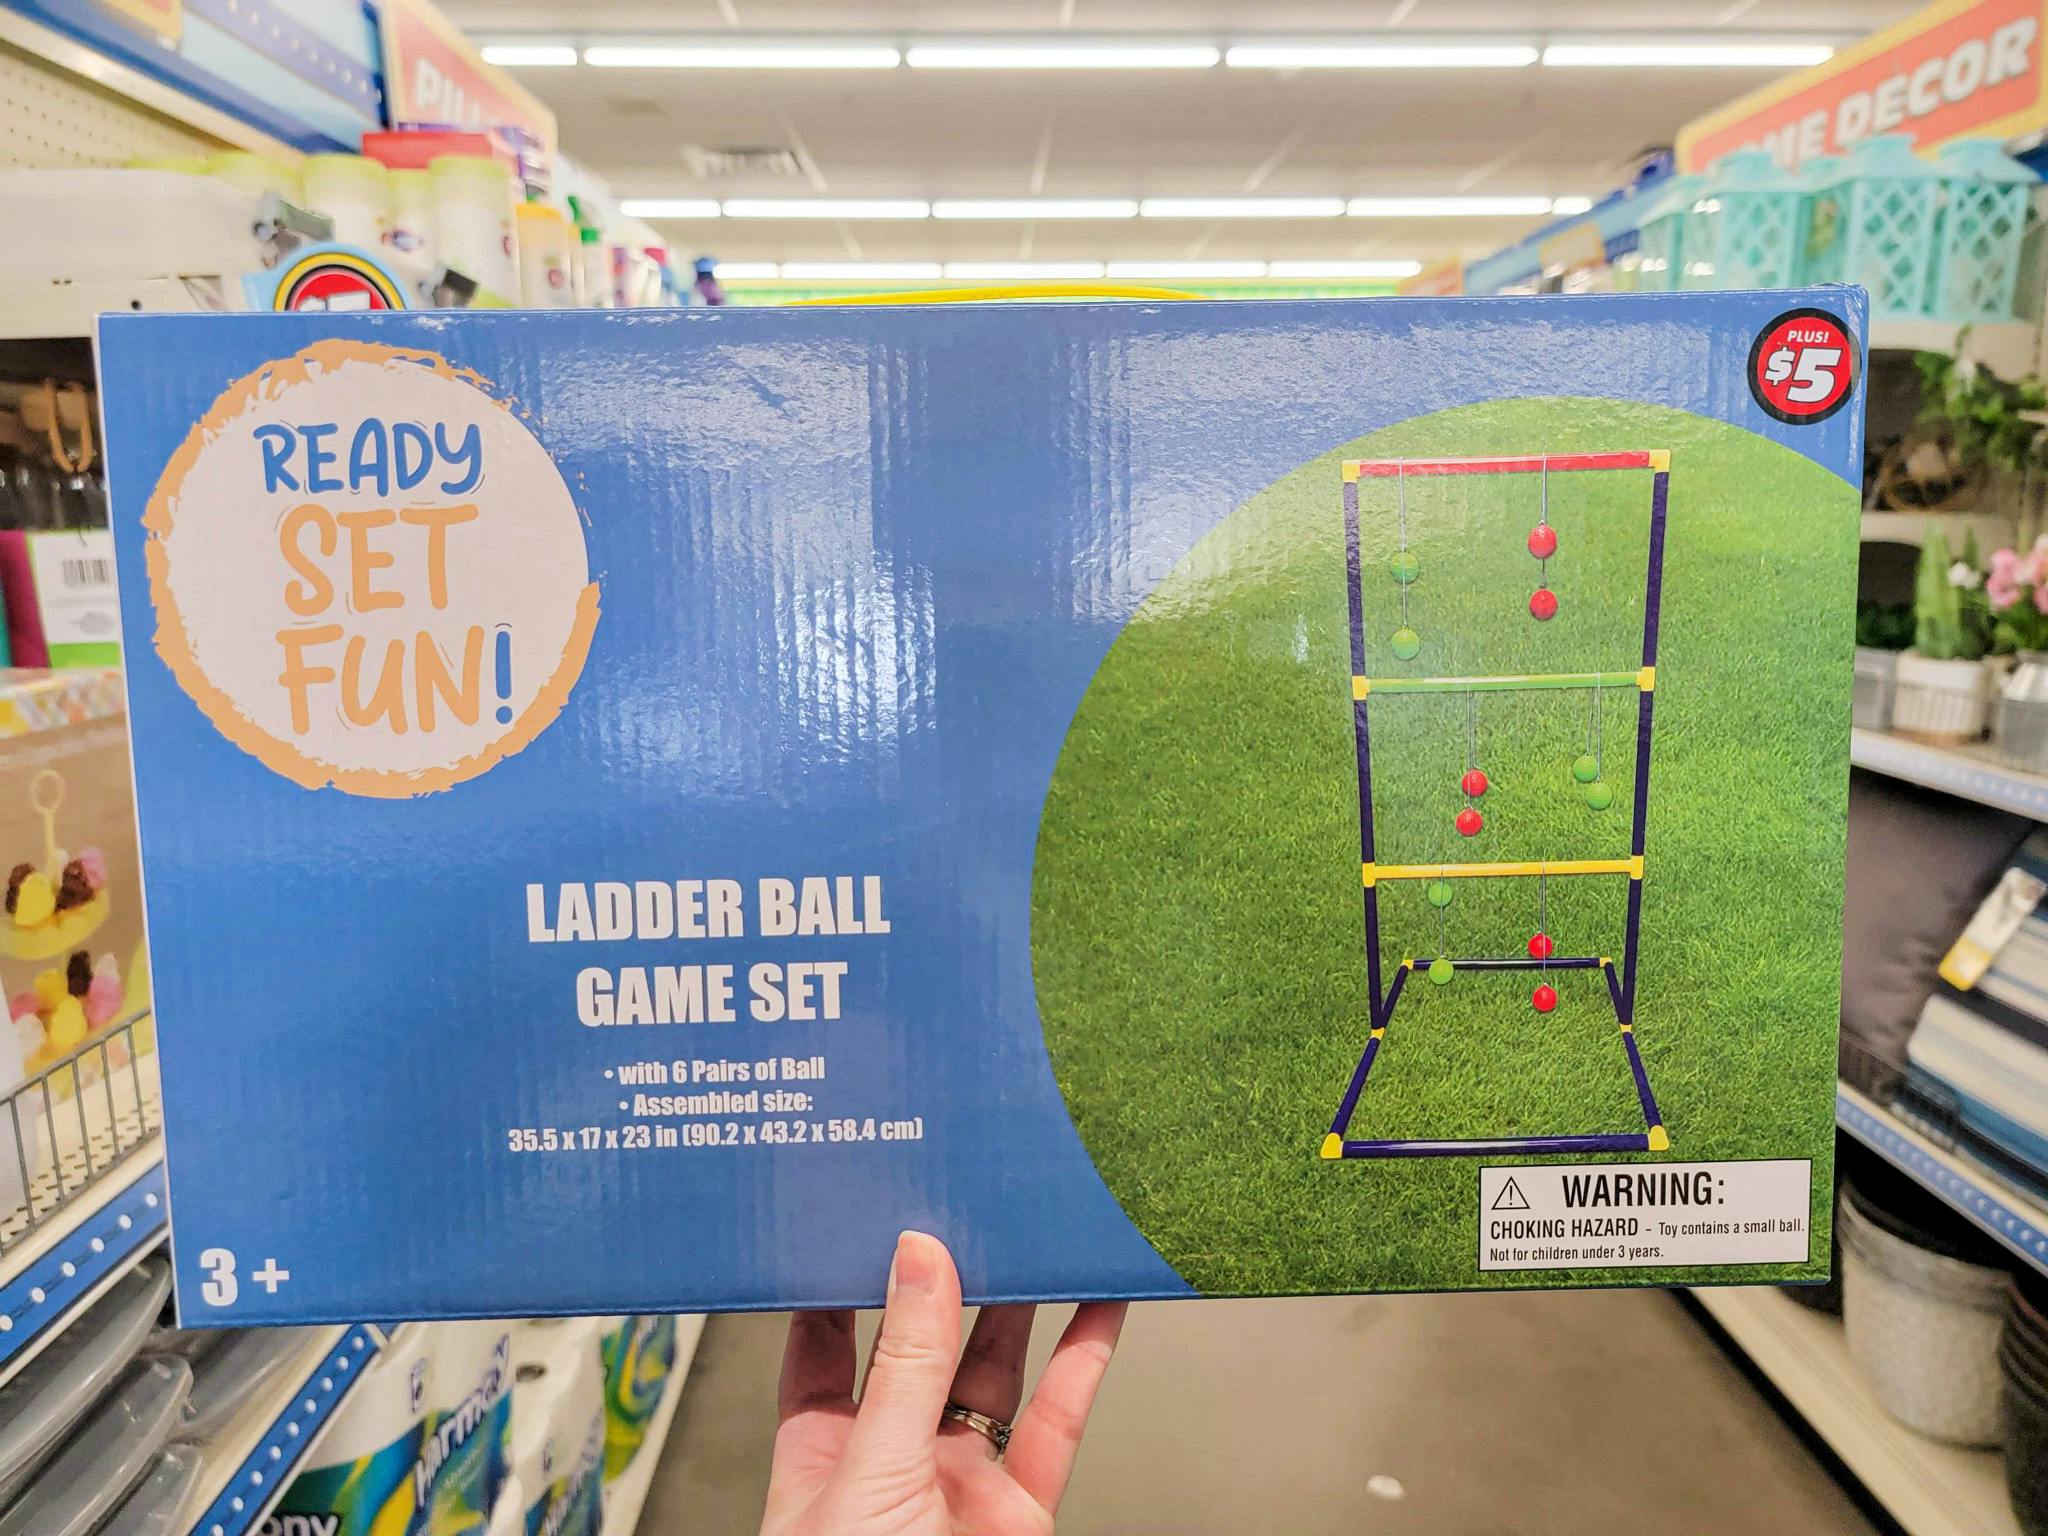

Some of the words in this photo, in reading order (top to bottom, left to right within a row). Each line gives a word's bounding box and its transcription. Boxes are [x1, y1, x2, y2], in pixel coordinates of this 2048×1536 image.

[1786, 329, 1829, 343] PLUS!
[1764, 345, 1843, 403] $5
[252, 417, 484, 498] READY
[279, 503, 480, 617] SET
[275, 624, 514, 736] FUN!
[526, 879, 744, 943] LADDER
[758, 875, 891, 937] BALL
[576, 964, 736, 1027] GAME
[748, 961, 848, 1022] SET
[617, 1061, 668, 1085] with
[672, 1060, 688, 1084] 6
[692, 1059, 751, 1083] Pairs
[754, 1057, 778, 1081] of
[780, 1056, 826, 1080] Ball
[633, 1090, 759, 1117] Assembled
[762, 1089, 814, 1113] size:
[508, 1128, 558, 1152] 35.5
[562, 1131, 576, 1151] x
[578, 1126, 601, 1150] 17
[605, 1129, 619, 1149] x
[622, 1124, 651, 1149] 23
[655, 1124, 678, 1148] in
[682, 1122, 739, 1147] (90.2
[743, 1125, 757, 1145] x
[759, 1119, 807, 1144] 43.2
[811, 1123, 825, 1143] x
[828, 1118, 877, 1143] 58.4
[880, 1117, 923, 1141] cm)
[1561, 1171, 1724, 1208] WARNING:
[1490, 1218, 1565, 1240] CHOKING
[1571, 1217, 1639, 1238] HAZARD
[1658, 1221, 1678, 1238] Toy
[1681, 1220, 1730, 1236] contains
[1733, 1222, 1740, 1234] a
[1743, 1218, 1776, 1234] small
[1779, 1218, 1804, 1233] ball.
[1490, 1247, 1510, 1262] Not
[1512, 1247, 1529, 1261] for
[1532, 1246, 1578, 1261] children
[1582, 1245, 1615, 1259] under
[1618, 1244, 1625, 1258] 3
[1628, 1246, 1664, 1261] years.
